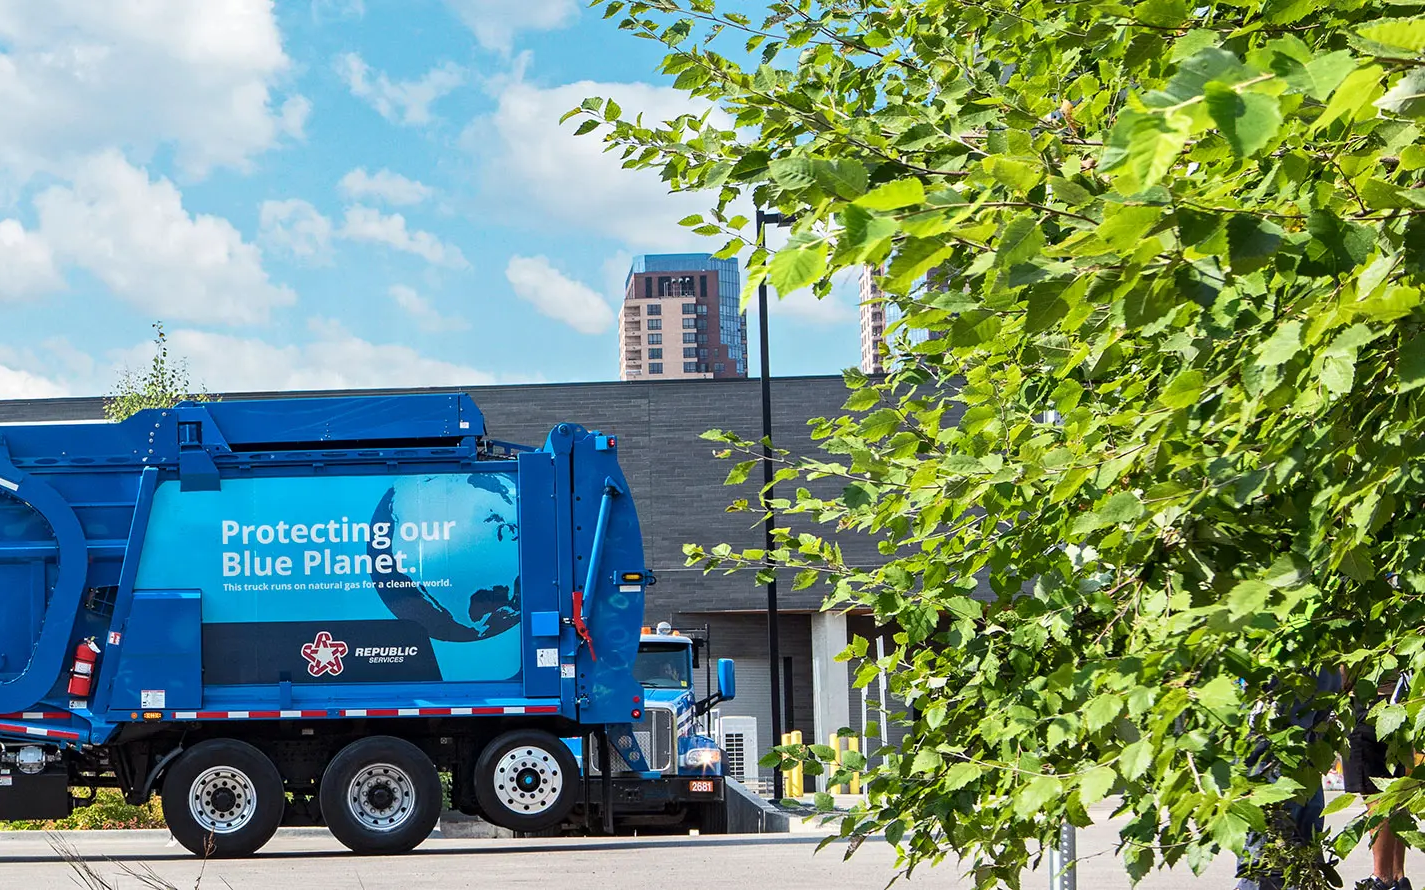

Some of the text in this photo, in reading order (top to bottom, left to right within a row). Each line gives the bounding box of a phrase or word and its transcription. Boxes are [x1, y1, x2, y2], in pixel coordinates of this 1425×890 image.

[222, 517, 456, 549] Protecting our
[222, 548, 417, 577] Blue Planet.
[223, 583, 242, 591] This
[244, 582, 269, 591] truck
[308, 581, 342, 590] natural
[344, 582, 360, 591] gas
[362, 580, 376, 588] for
[386, 580, 421, 588] cleaner
[423, 579, 453, 587] world.
[355, 647, 418, 656] REPUBLIC
[692, 781, 711, 791] 2681
